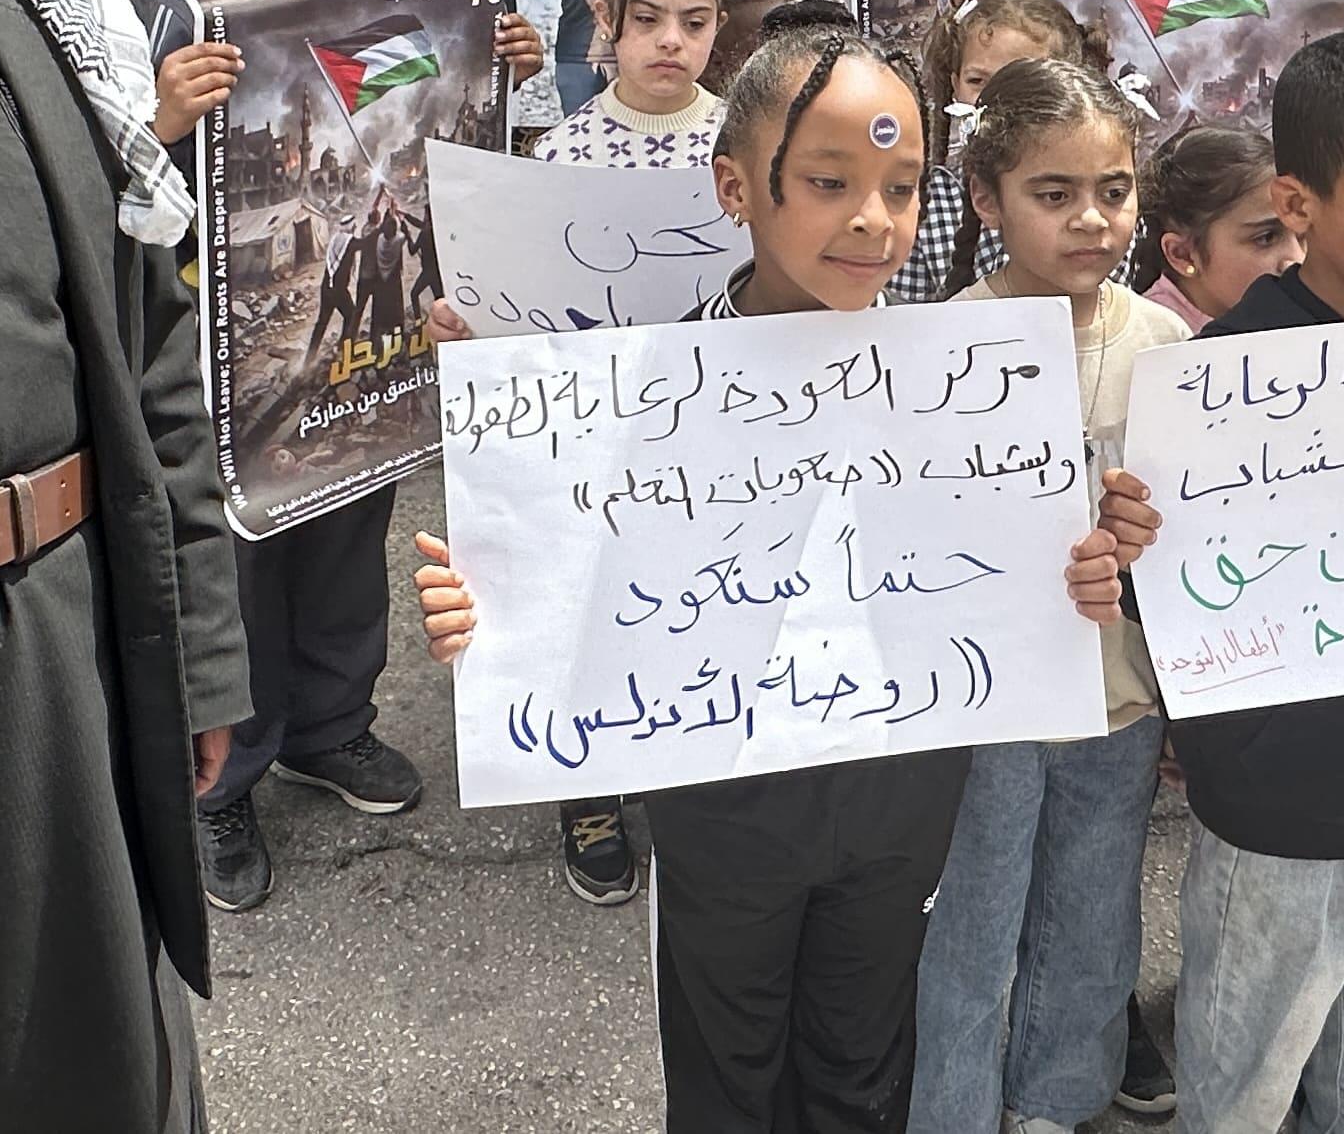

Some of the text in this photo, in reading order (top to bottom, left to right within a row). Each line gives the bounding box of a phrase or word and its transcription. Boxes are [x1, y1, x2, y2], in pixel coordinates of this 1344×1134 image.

[212, 146, 226, 186] Than
[212, 191, 227, 247] Deeper
[214, 250, 228, 278] Are
[215, 282, 229, 327] Roots
[216, 329, 229, 361] Our
[328, 325, 403, 385] نرحل
[382, 366, 423, 404] أعمق
[552, 346, 704, 442] لرعاية
[719, 343, 895, 426] العودة
[912, 338, 1042, 414] مركز
[1176, 339, 1330, 431] لرعاية
[297, 399, 356, 438] دماركم
[356, 390, 381, 415] من
[218, 416, 232, 447] Not
[219, 448, 237, 483] Will
[230, 483, 248, 511] We
[1179, 533, 1307, 611] حق
